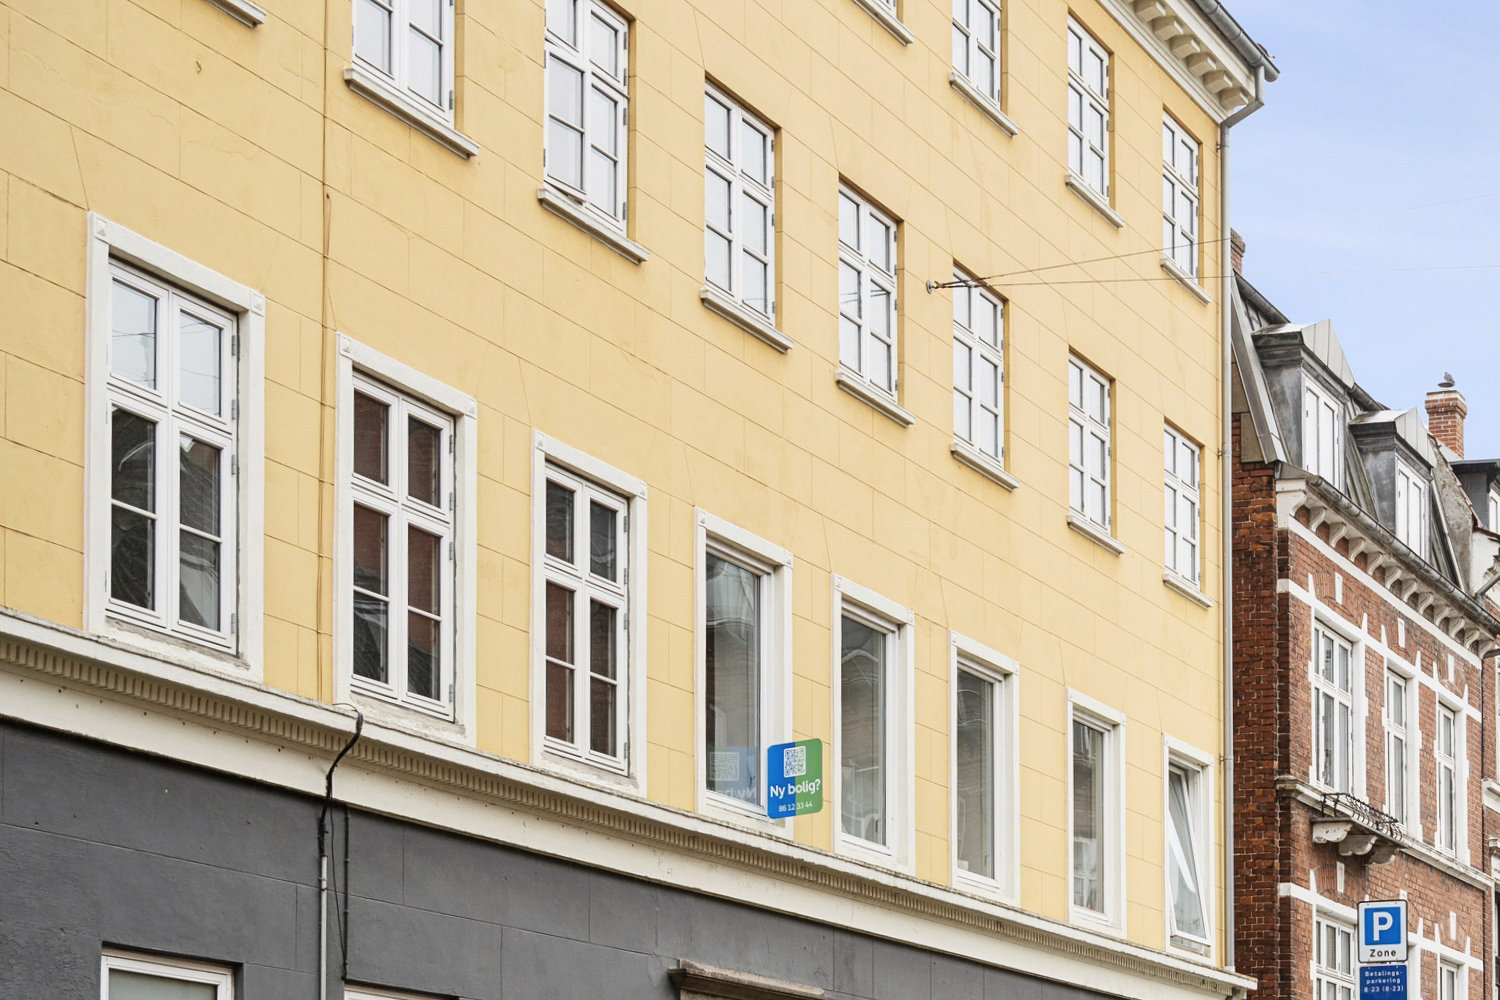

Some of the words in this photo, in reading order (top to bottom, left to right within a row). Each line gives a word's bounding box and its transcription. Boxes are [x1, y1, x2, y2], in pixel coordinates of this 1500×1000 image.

[770, 785, 785, 799] Ny
[788, 779, 820, 794] bolig?
[1373, 911, 1394, 941] P
[1369, 948, 1397, 958] Zone
[1366, 977, 1401, 985] parkering
[1382, 984, 1404, 992] (8-23)
